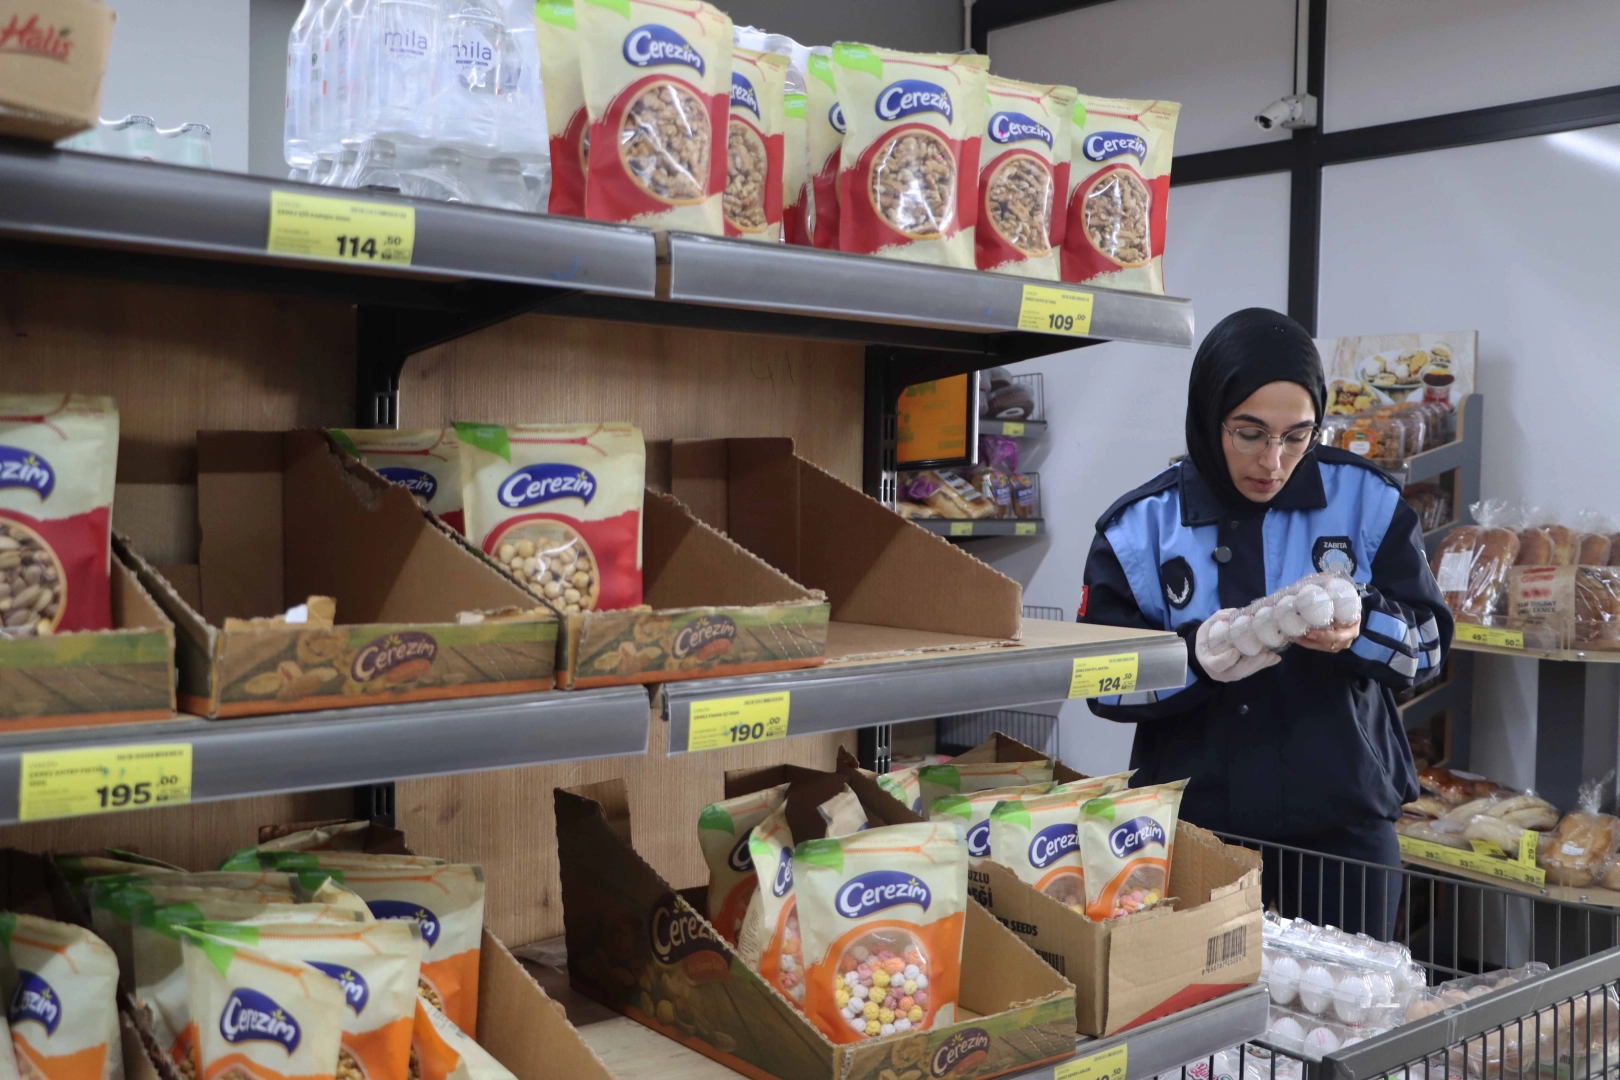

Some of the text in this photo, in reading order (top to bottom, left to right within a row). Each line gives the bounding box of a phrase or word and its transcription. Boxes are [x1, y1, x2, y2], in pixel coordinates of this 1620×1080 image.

[384, 30, 428, 50] mila
[627, 30, 701, 68] Çerezim
[879, 87, 951, 120] Çerezim
[992, 115, 1051, 142] Çerezim
[1086, 135, 1146, 161] Çerezim
[336, 234, 377, 259] 114
[1049, 313, 1074, 331] 109
[502, 471, 593, 507] Çerezim
[1323, 541, 1348, 549] ZABITA
[674, 620, 734, 658] Çerezim
[355, 638, 435, 681] Çerezim
[1098, 676, 1121, 693] 124
[730, 722, 765, 743] 190
[96, 782, 152, 808] 195
[1111, 826, 1162, 858] Çerezim
[840, 882, 927, 917] Çerezim
[1011, 920, 1038, 937] SEEDS
[221, 995, 296, 1041] Çerezim
[933, 1033, 988, 1077] Çerezim
